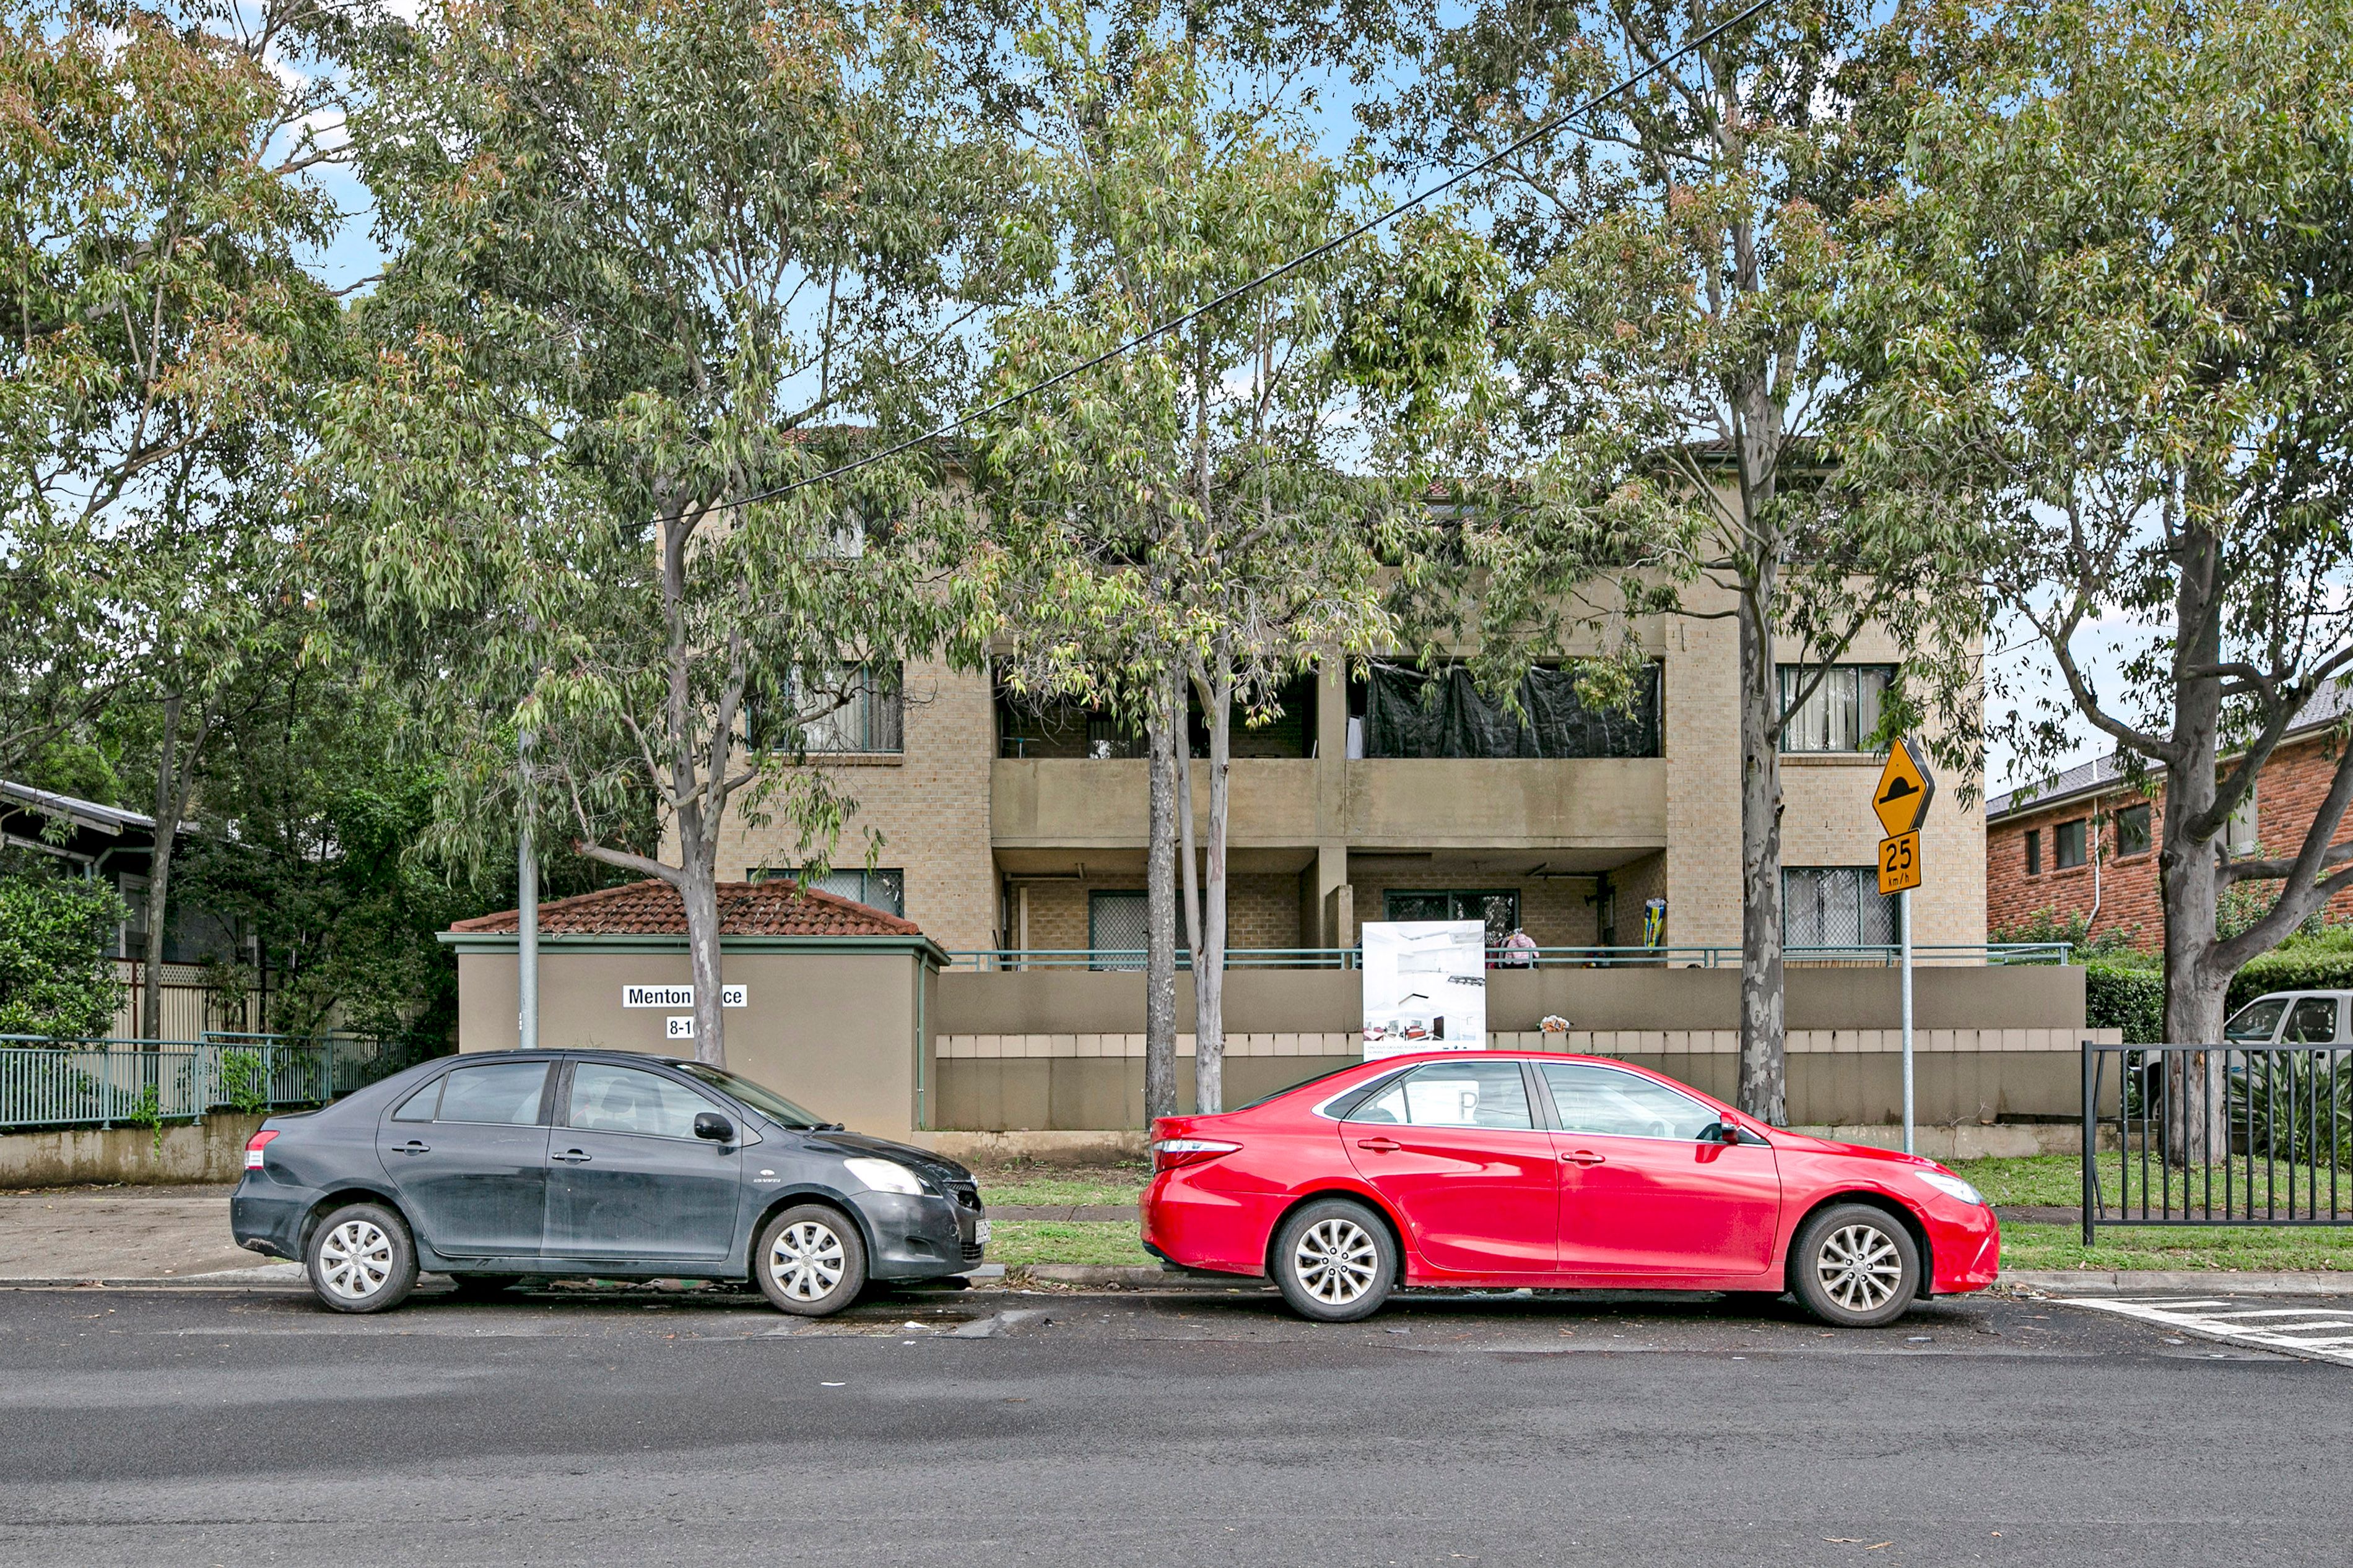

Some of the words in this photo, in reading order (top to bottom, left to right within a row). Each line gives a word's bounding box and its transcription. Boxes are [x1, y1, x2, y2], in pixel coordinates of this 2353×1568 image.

[1885, 838, 1912, 872] 25
[1888, 872, 1909, 886] km/h
[628, 989, 691, 1003] Menton
[669, 1020, 695, 1034] 8-1
